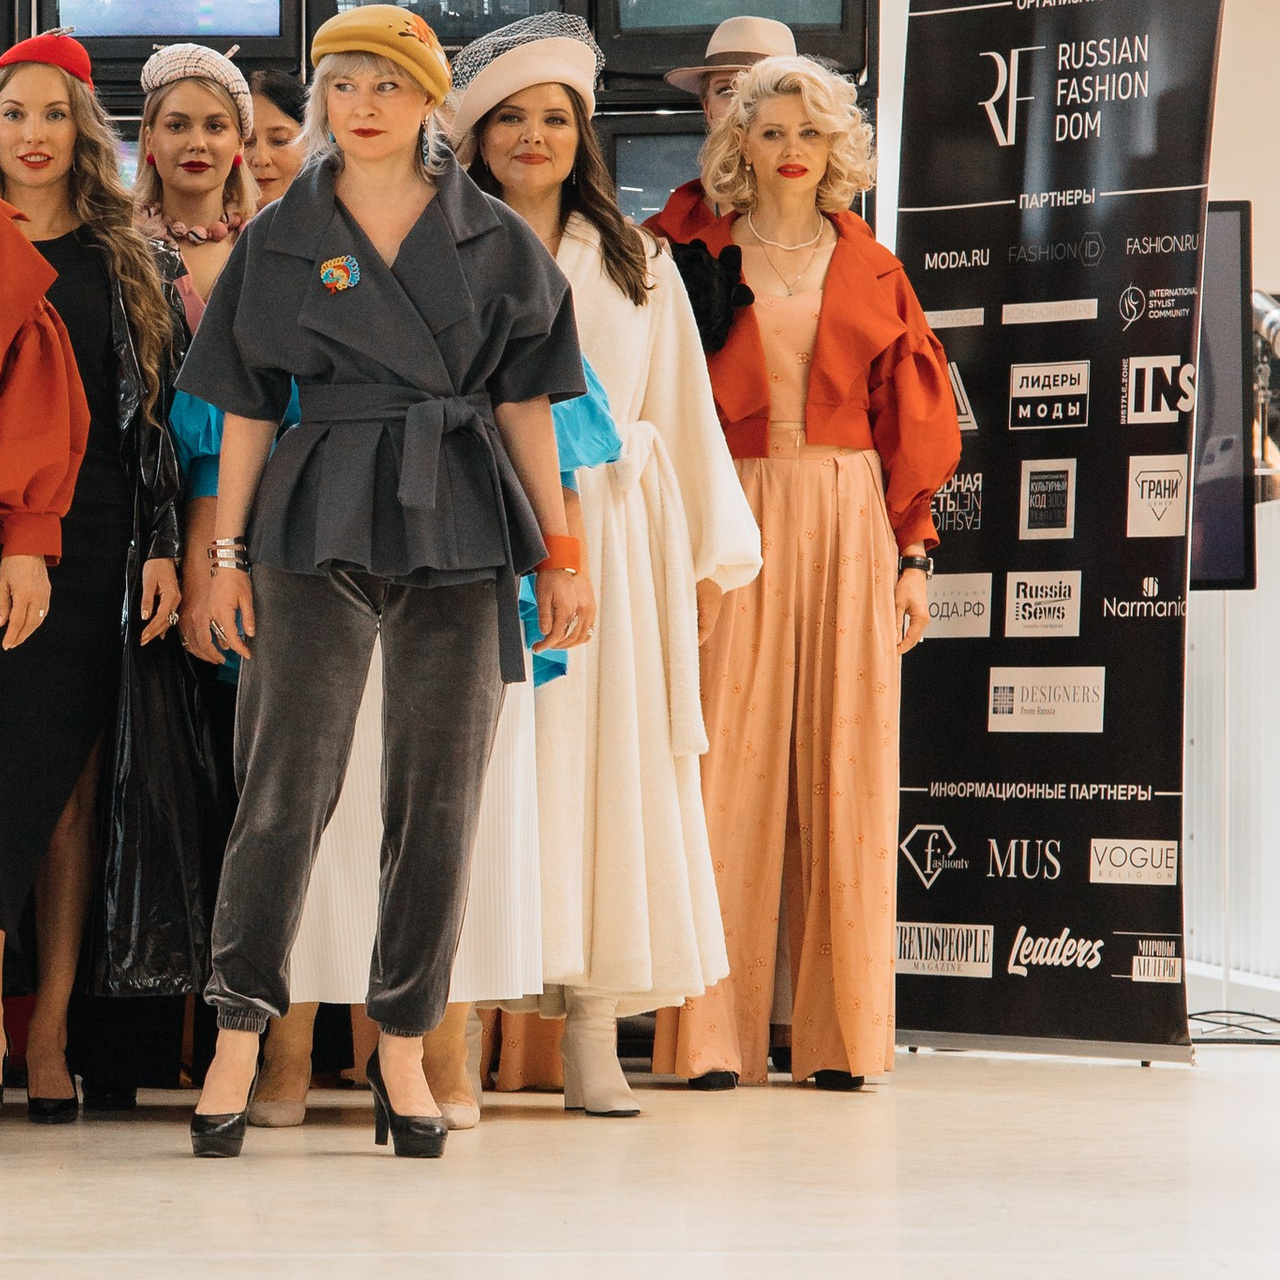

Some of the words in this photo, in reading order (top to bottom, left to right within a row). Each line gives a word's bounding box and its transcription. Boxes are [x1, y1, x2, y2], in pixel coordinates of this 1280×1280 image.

[1057, 34, 1149, 71] RUSSIAN
[1057, 71, 1149, 106] FASHION
[1055, 110, 1101, 142] DOM
[1019, 188, 1096, 209] ПАРТНЕРЫ
[925, 248, 990, 270] MODA.RU
[1148, 308, 1190, 319] COMMUNITY
[1149, 299, 1176, 309] STYLIST
[1019, 373, 1081, 390] ЛИДЕРЫ
[1018, 402, 1080, 419] МОДЫ
[1141, 478, 1179, 499] ГРАНИ
[929, 493, 956, 512] ЕТЬ
[1030, 494, 1047, 509] КОД
[931, 510, 982, 531] FASHIO
[1016, 581, 1071, 599] Russia
[929, 601, 985, 621] ОДА.РФ
[1020, 685, 1100, 704] DESIGNERS
[930, 781, 1066, 802] ИНФОРМАЦИОННЫЕ
[1070, 783, 1152, 801] ПАРТНЕРЫ
[986, 838, 1062, 880] MUS
[1093, 846, 1175, 869] VOGUE
[1098, 871, 1173, 880] RELIGION
[897, 926, 990, 963] RENDSPEOPLE
[1008, 925, 1104, 977] Leaders
[913, 961, 963, 973] MAGAZINE
